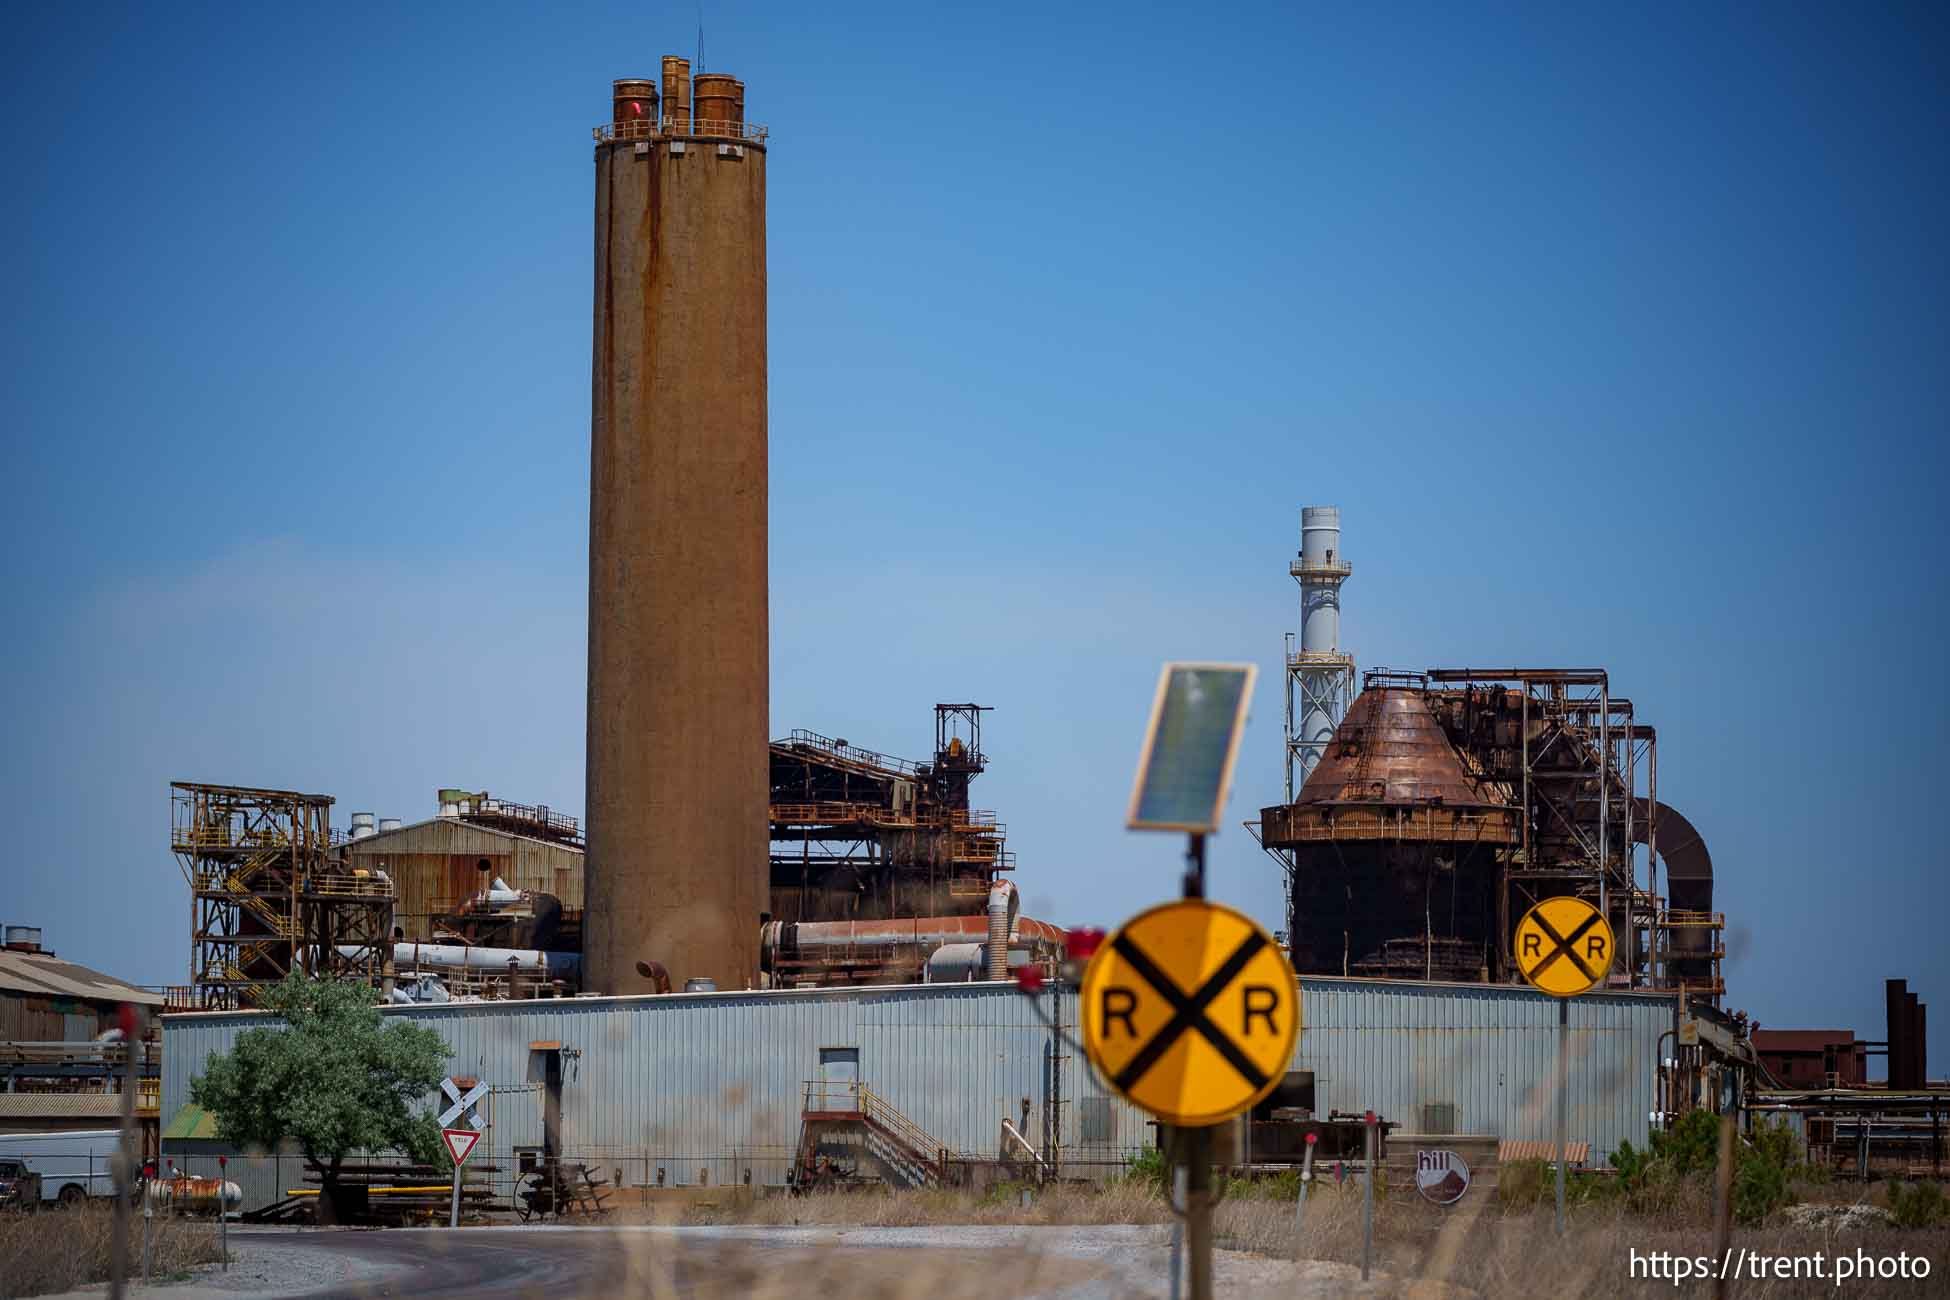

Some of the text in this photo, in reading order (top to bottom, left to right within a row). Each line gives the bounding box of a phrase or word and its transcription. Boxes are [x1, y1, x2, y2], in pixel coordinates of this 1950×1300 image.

[1524, 934, 1605, 960] R R
[1102, 986, 1279, 1038] R R
[1419, 1151, 1450, 1170] hill
